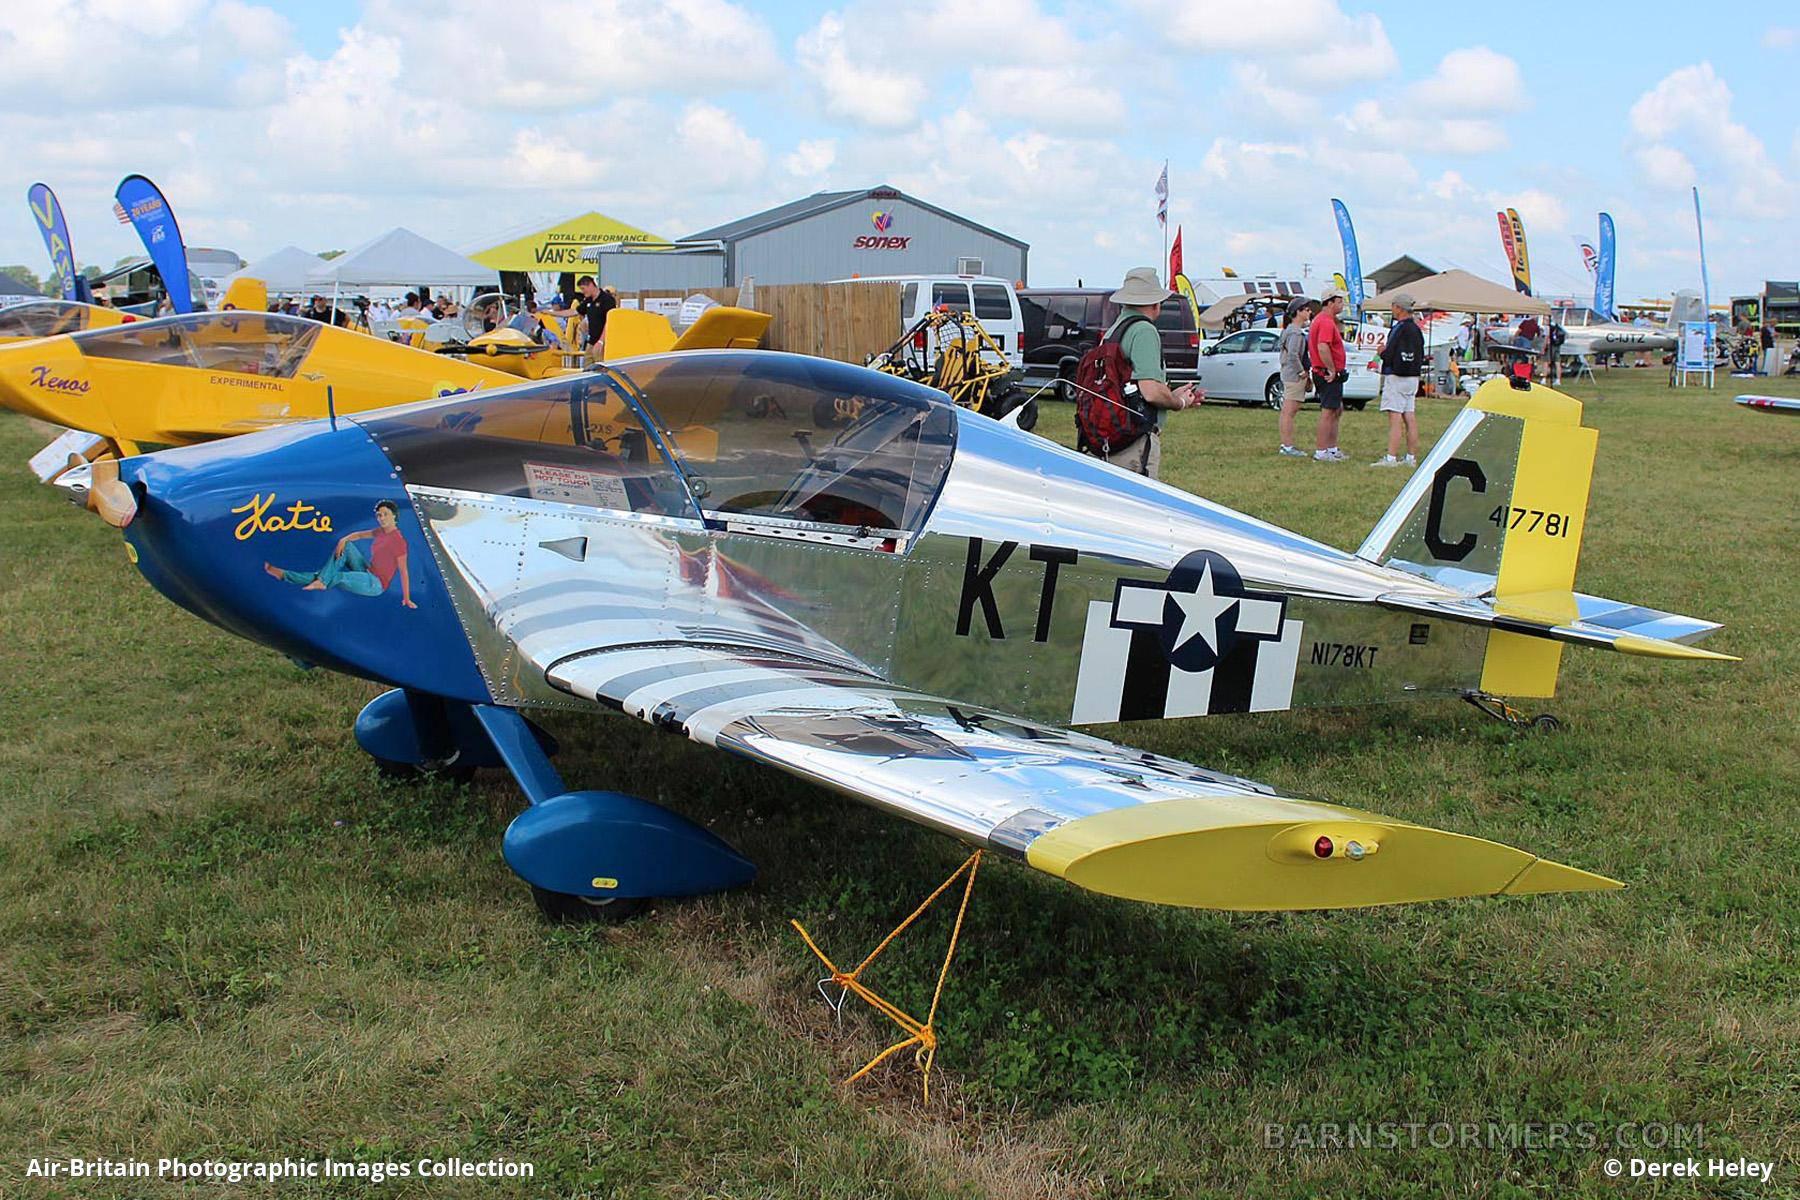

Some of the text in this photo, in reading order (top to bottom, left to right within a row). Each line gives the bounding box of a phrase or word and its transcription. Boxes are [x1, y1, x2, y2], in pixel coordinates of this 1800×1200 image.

[547, 233, 650, 242] TOTAL PERFORMANCE
[853, 235, 912, 249] sonex
[535, 243, 577, 264] VAN'S
[30, 366, 91, 393] Xenos
[210, 376, 285, 392] EXPERIMENTAL
[533, 468, 571, 479] PLEASE
[535, 474, 554, 482] NOT
[557, 477, 590, 487] TOUCH
[231, 493, 333, 540] Katie
[1424, 457, 1487, 562] C
[1489, 505, 1569, 538] 417781
[955, 536, 1078, 642] KT
[1311, 642, 1378, 668] N178KT
